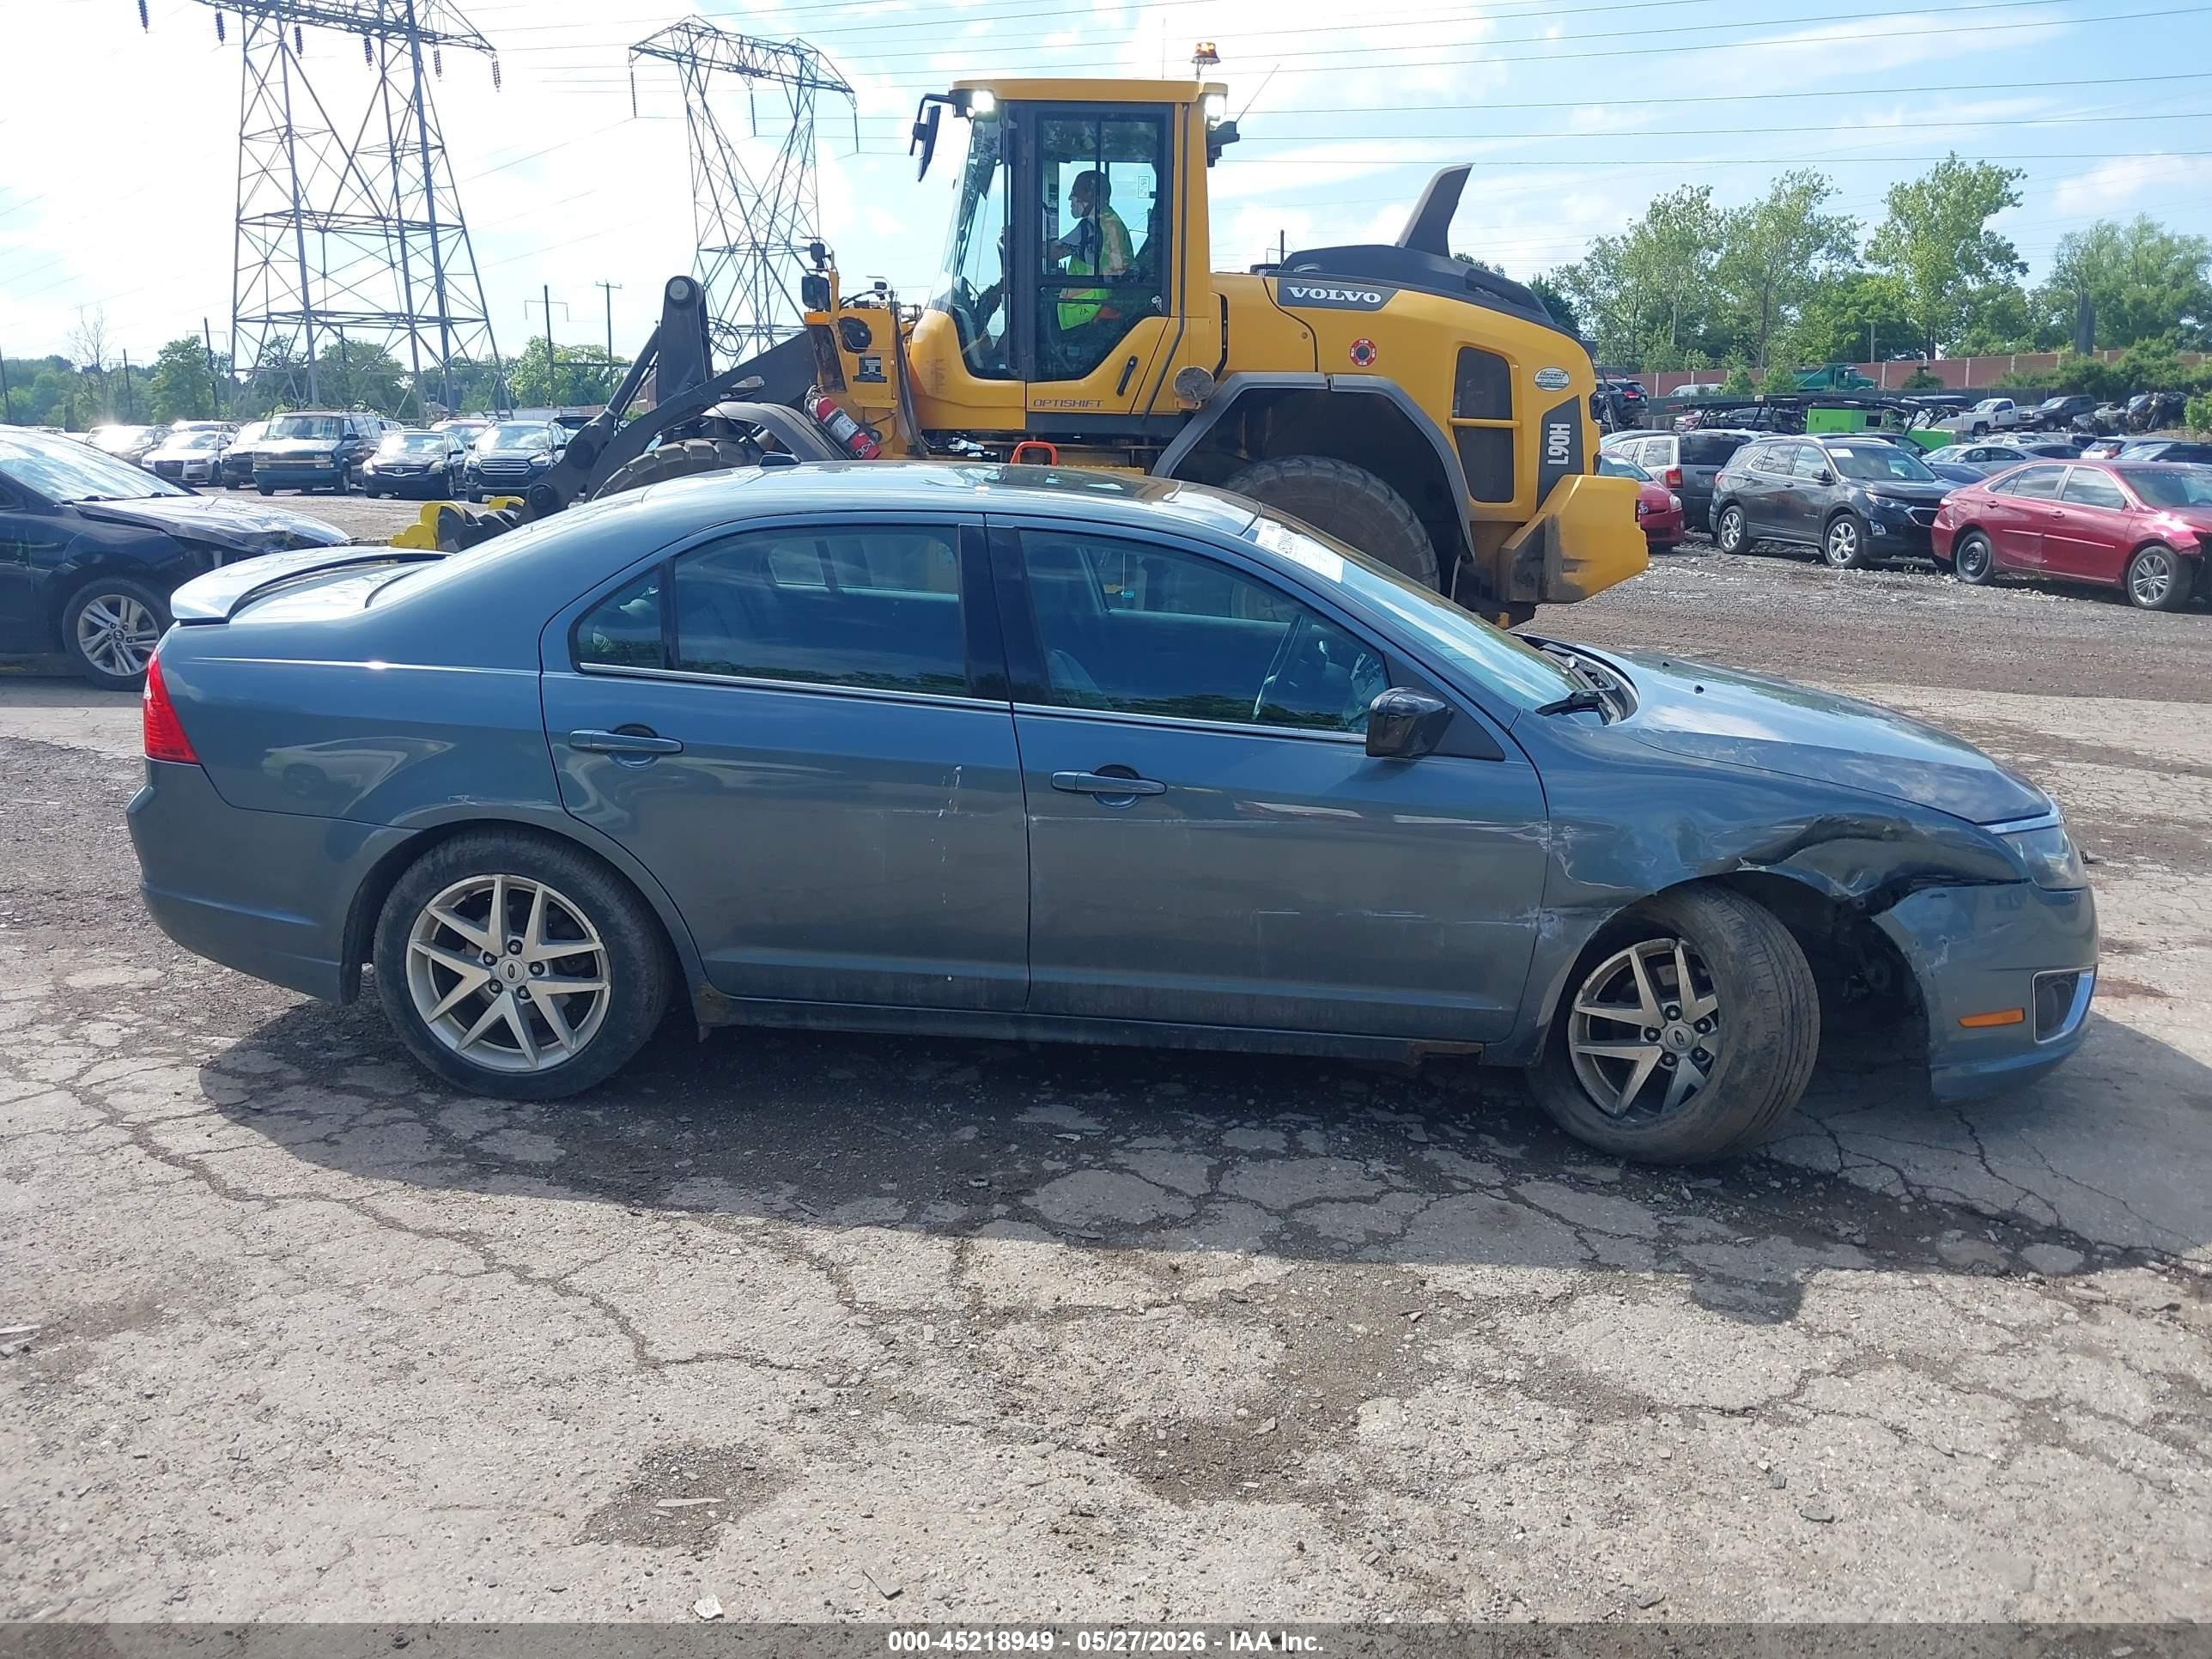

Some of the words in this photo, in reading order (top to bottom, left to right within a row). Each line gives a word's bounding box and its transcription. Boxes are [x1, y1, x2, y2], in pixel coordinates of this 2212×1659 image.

[1287, 287, 1382, 303] VOLVO
[1033, 398, 1104, 408] OPTISHIFT
[1547, 423, 1571, 465] L90H
